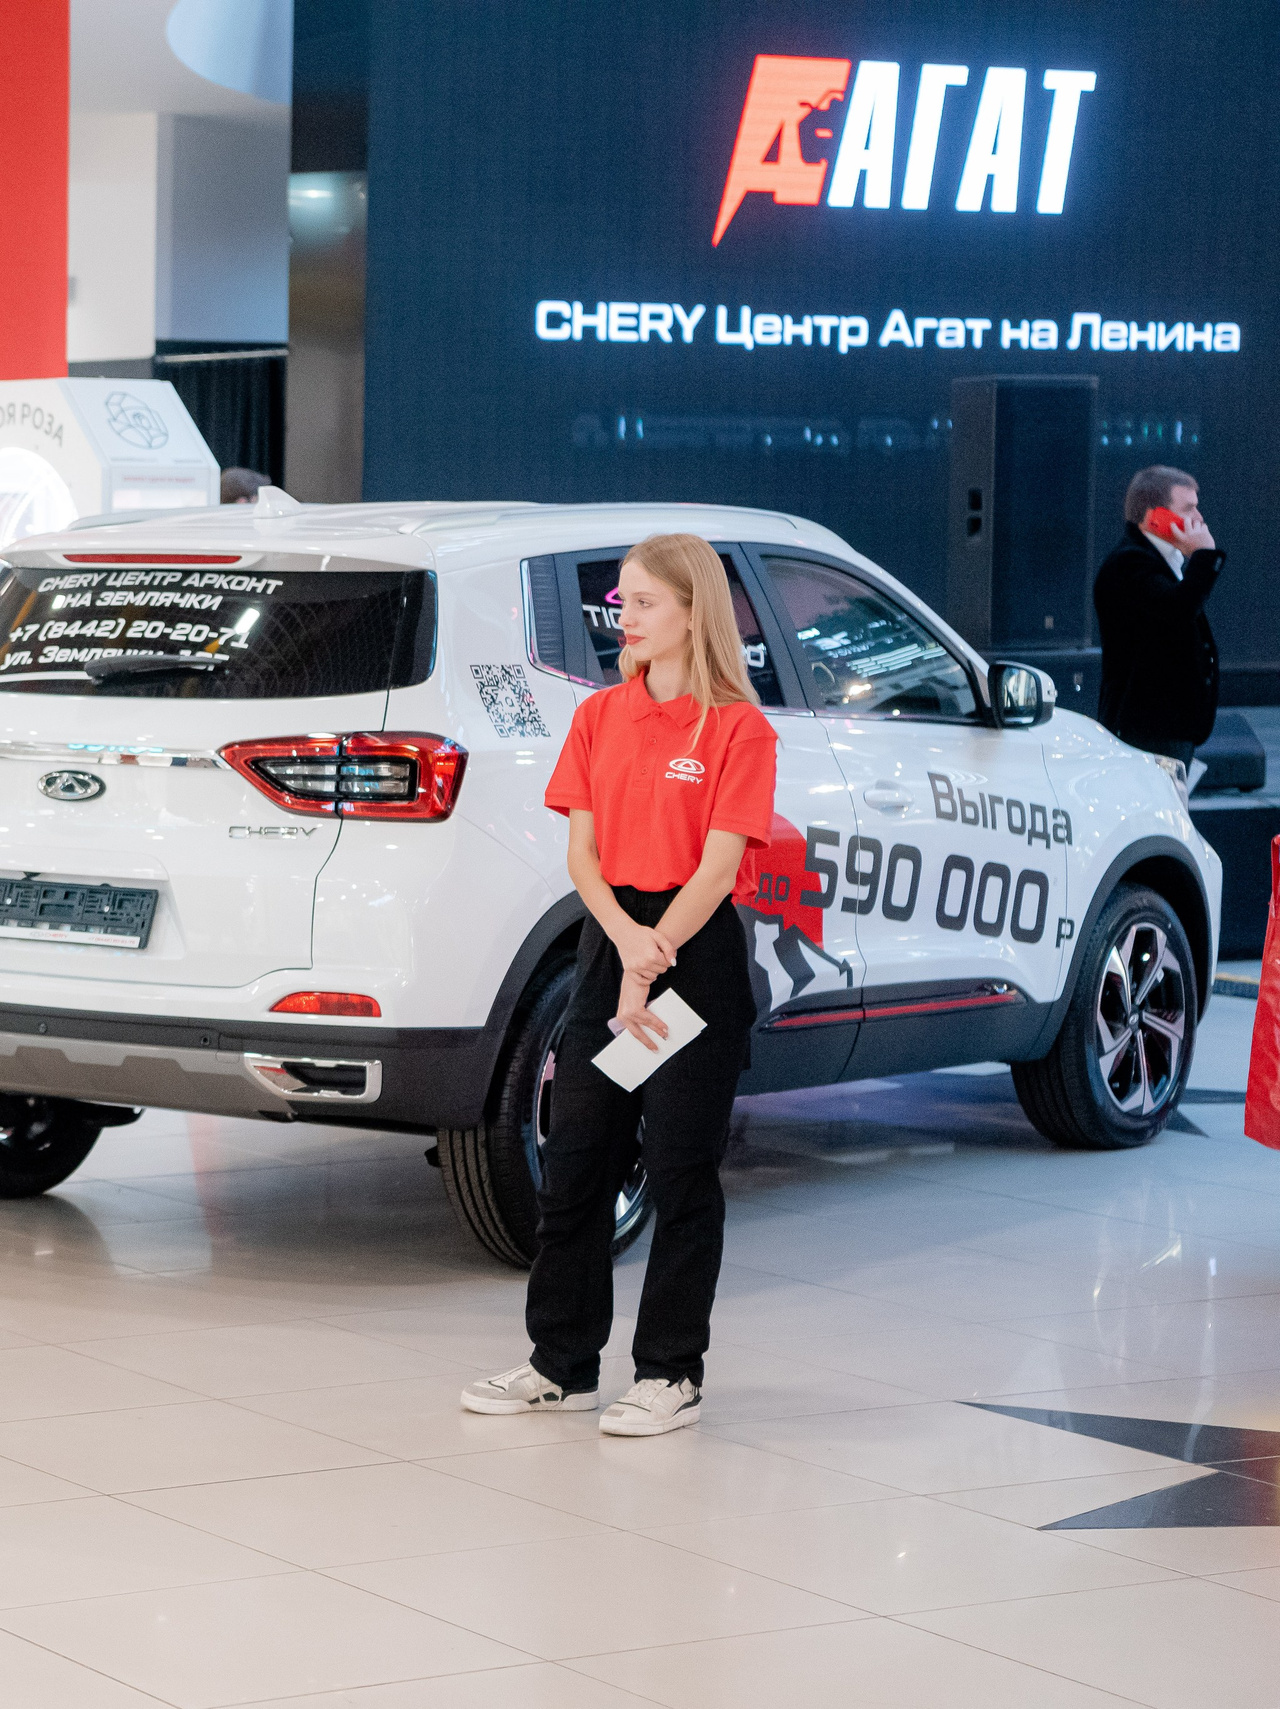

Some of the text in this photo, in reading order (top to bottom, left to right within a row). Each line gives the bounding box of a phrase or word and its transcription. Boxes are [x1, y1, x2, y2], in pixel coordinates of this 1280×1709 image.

[827, 60, 1097, 215] АГАТ
[535, 300, 1241, 354] CHERY Центр Агат на Ленина
[21, 402, 65, 447] РОЗА
[38, 571, 284, 595] CHERY ЦЕНТР АРКОНТ
[62, 591, 223, 611] НА ЗЕМЛЯЧКИ
[9, 624, 40, 643] +7
[39, 618, 125, 642] (8442)
[0, 650, 34, 670] ул.
[665, 771, 704, 785] CHERY
[927, 771, 1073, 849] Выгода
[228, 826, 318, 840] CHERY
[754, 872, 791, 906] до
[799, 825, 922, 922] 590
[935, 854, 1050, 944] 000
